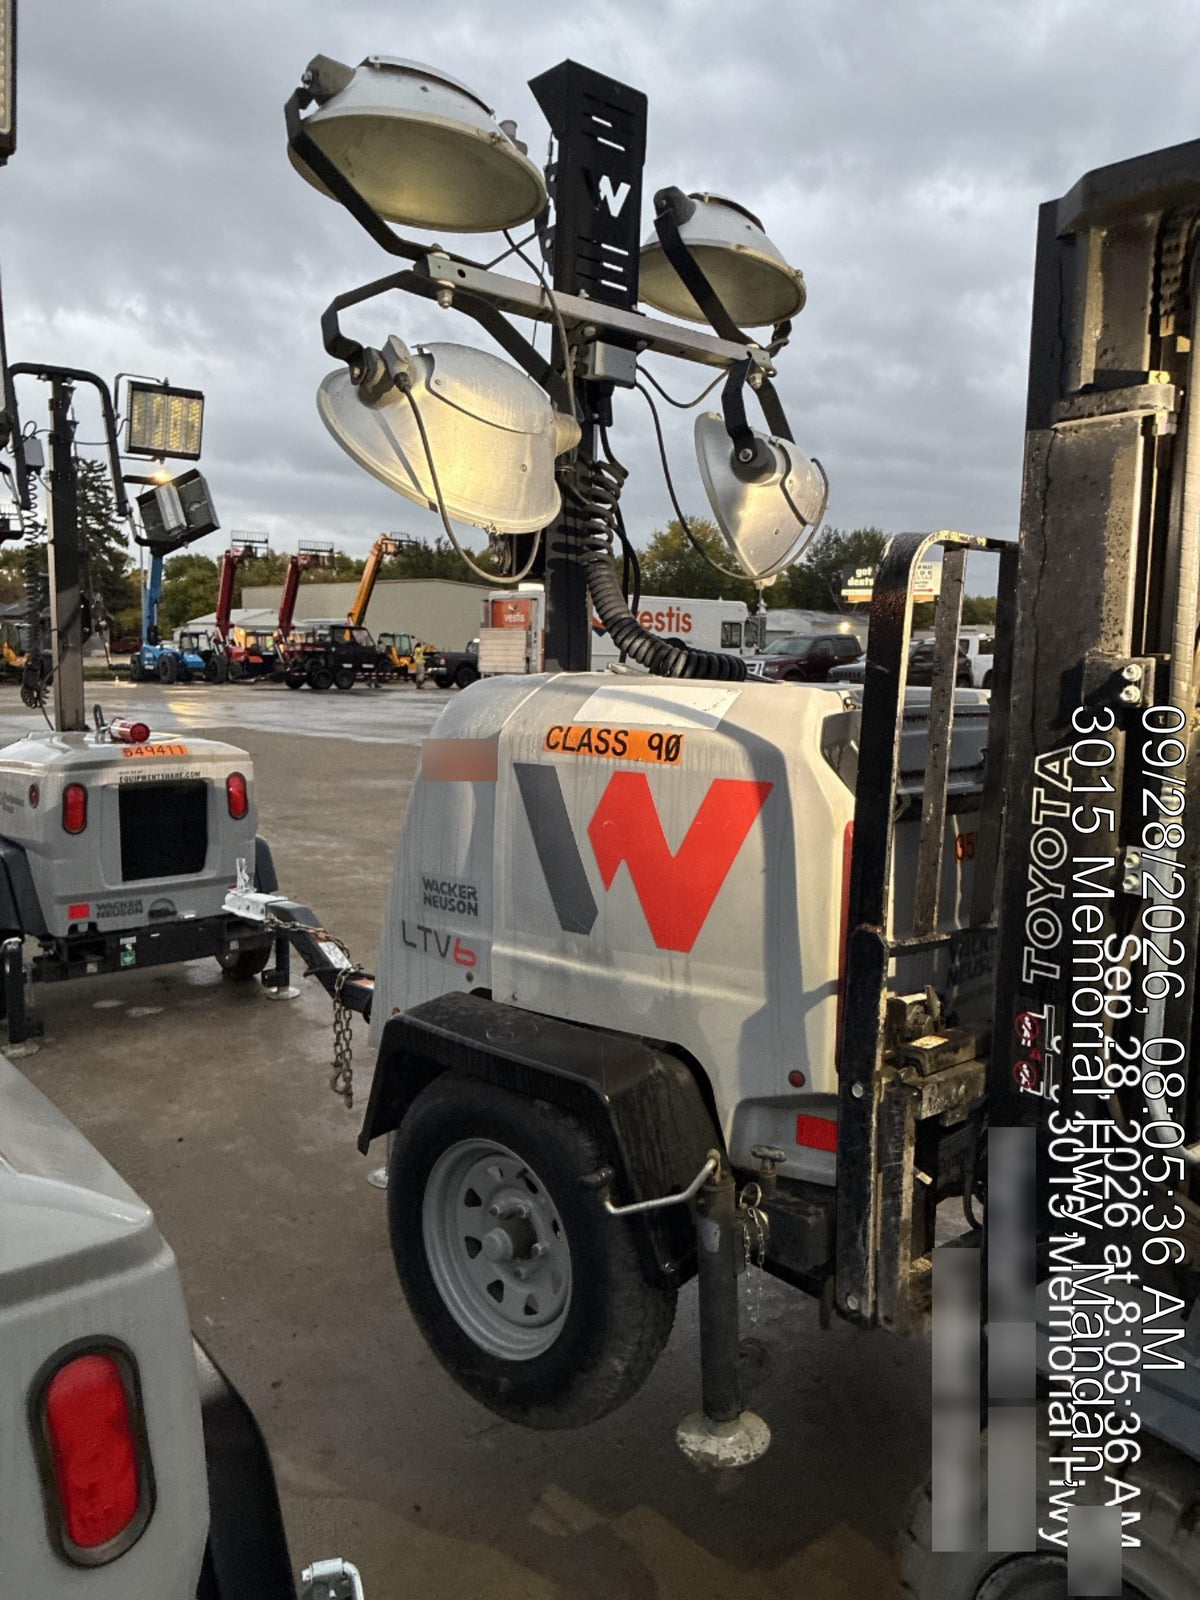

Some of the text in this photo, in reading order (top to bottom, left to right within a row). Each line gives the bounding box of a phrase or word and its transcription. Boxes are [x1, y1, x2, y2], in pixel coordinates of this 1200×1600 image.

[855, 567, 873, 578] got
[545, 725, 629, 757] CLASS
[1022, 745, 1073, 984] TOYOTA
[421, 877, 478, 902] WACKER
[422, 891, 478, 917] NEUSON
[401, 919, 477, 968] LTV6
